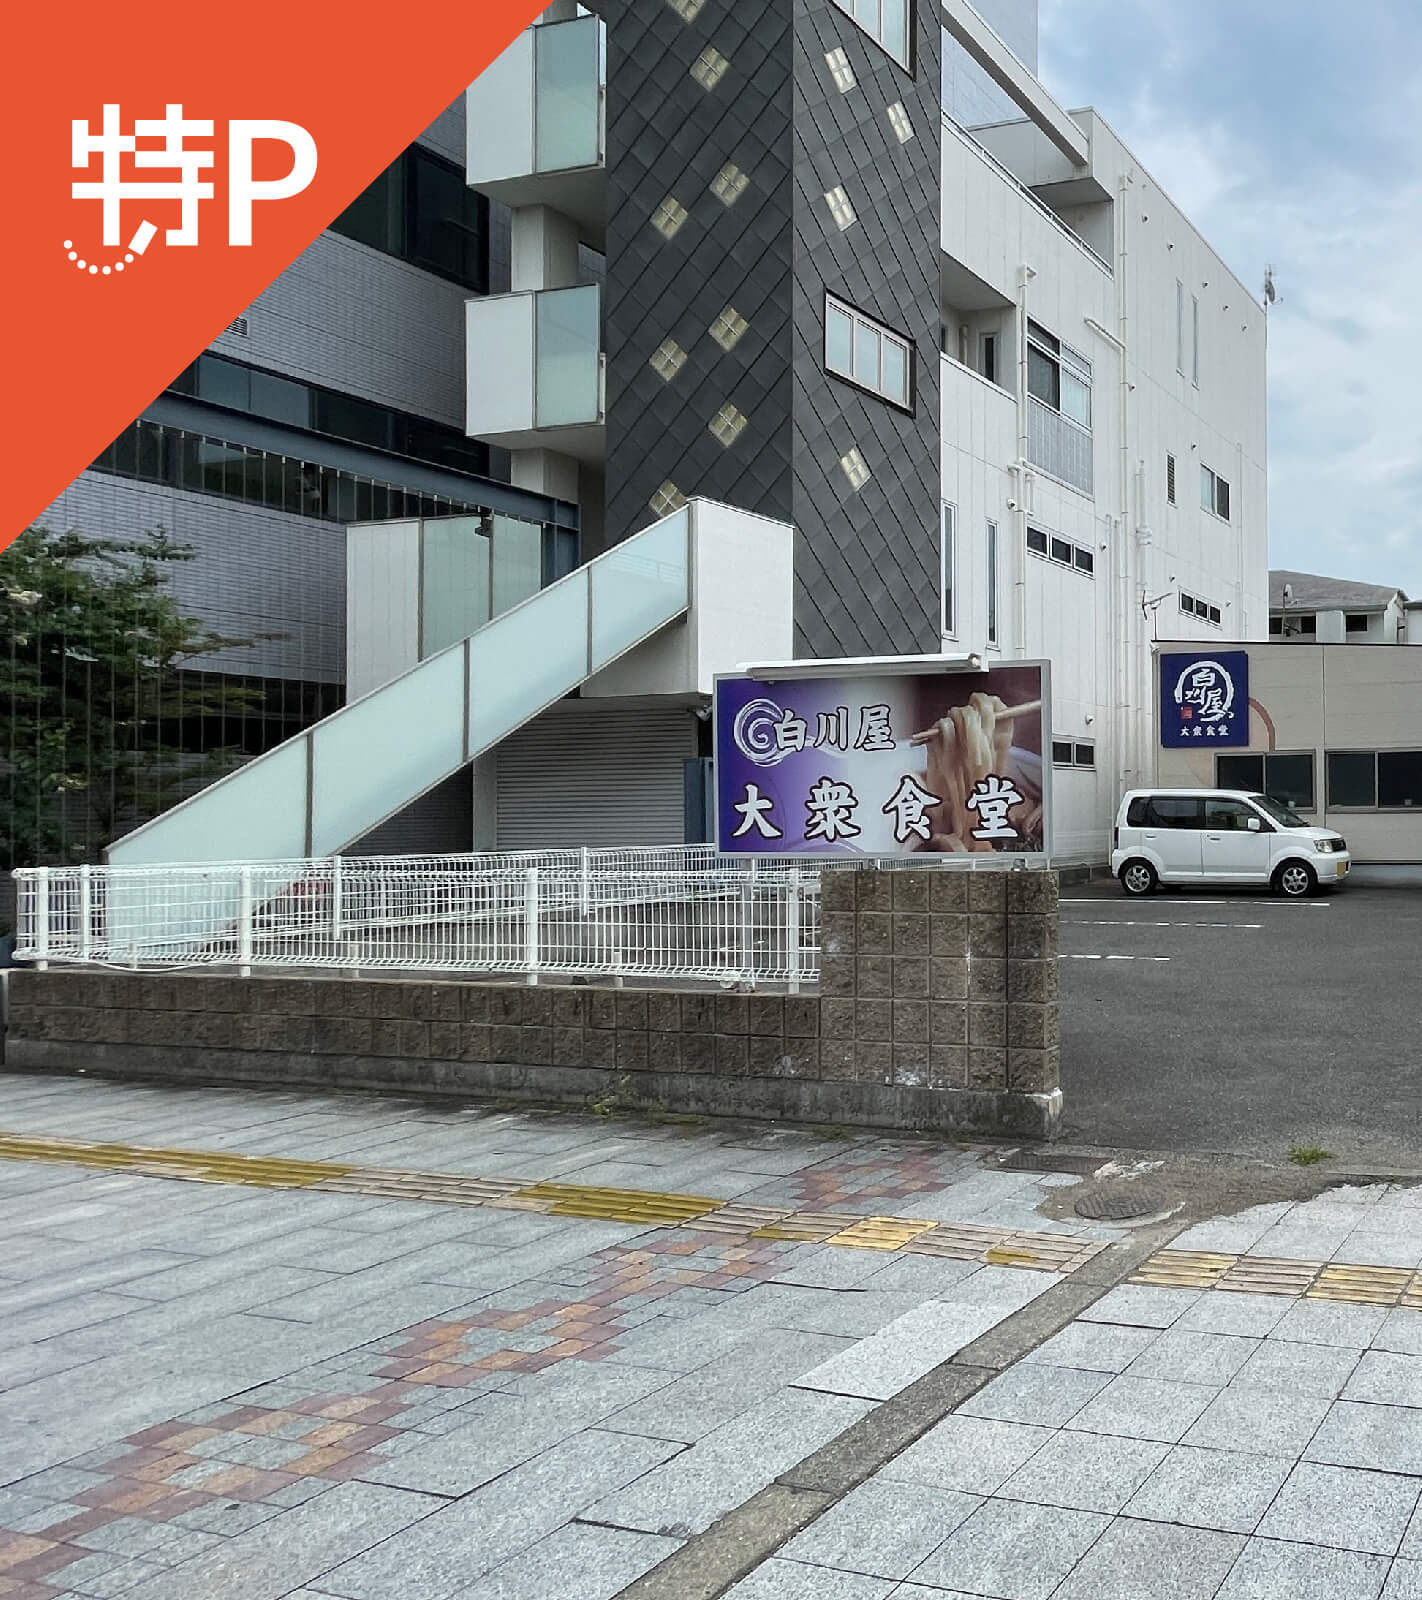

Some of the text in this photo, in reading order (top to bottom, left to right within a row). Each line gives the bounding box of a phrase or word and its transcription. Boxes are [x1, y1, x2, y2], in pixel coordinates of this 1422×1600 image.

[773, 705, 896, 751] 白川屋
[1180, 725, 1229, 737] 大衆食堂
[731, 774, 1024, 842] 大衆食堂
